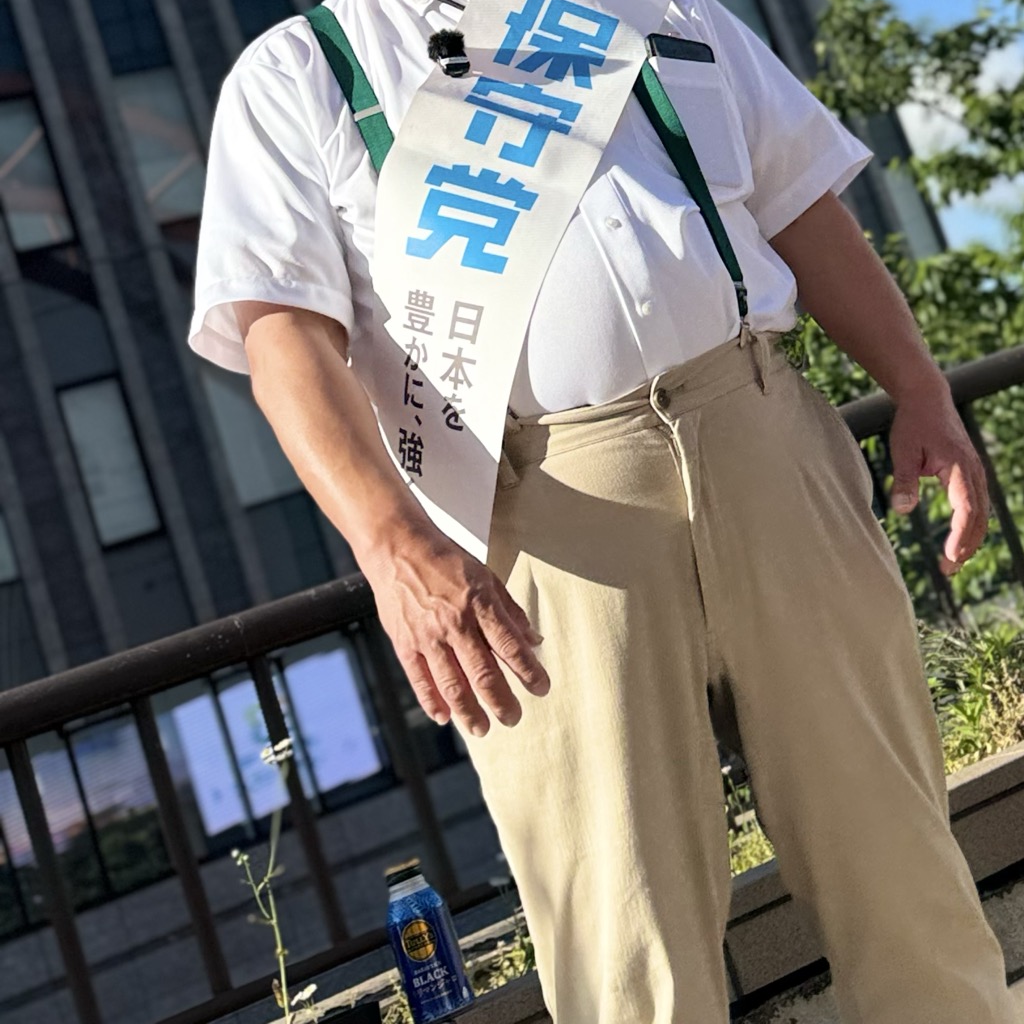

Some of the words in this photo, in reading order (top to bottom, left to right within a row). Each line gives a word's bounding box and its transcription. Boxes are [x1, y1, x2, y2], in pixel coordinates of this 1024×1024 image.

[399, 288, 435, 486] 豊かに、強
[439, 300, 485, 432] 日本を
[412, 965, 449, 988] BLACK
